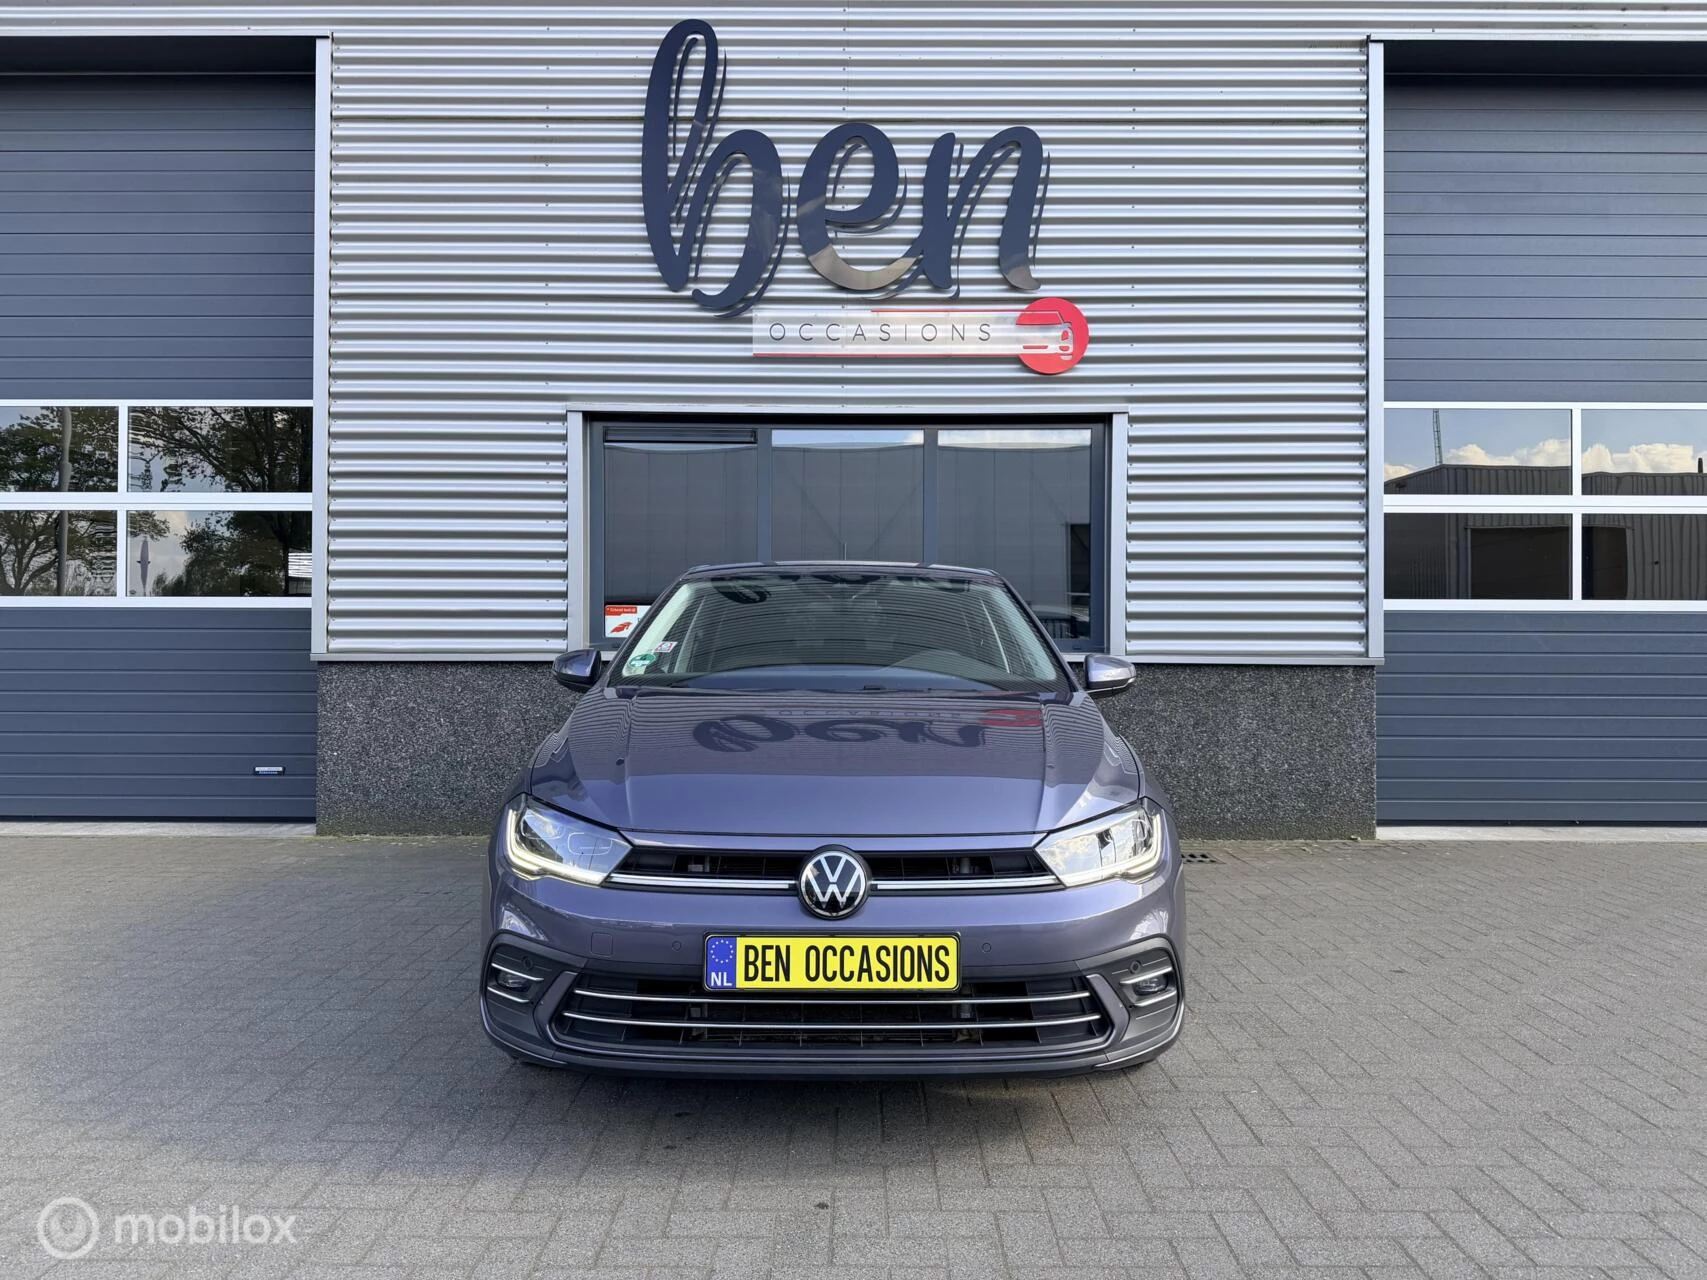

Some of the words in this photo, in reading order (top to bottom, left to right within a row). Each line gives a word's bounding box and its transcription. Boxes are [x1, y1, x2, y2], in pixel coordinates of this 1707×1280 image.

[641, 18, 1050, 318] ben
[769, 322, 991, 342] OCCASIONS
[743, 944, 791, 982] BEN
[804, 944, 950, 982] OCCASIONS
[710, 971, 732, 987] NL
